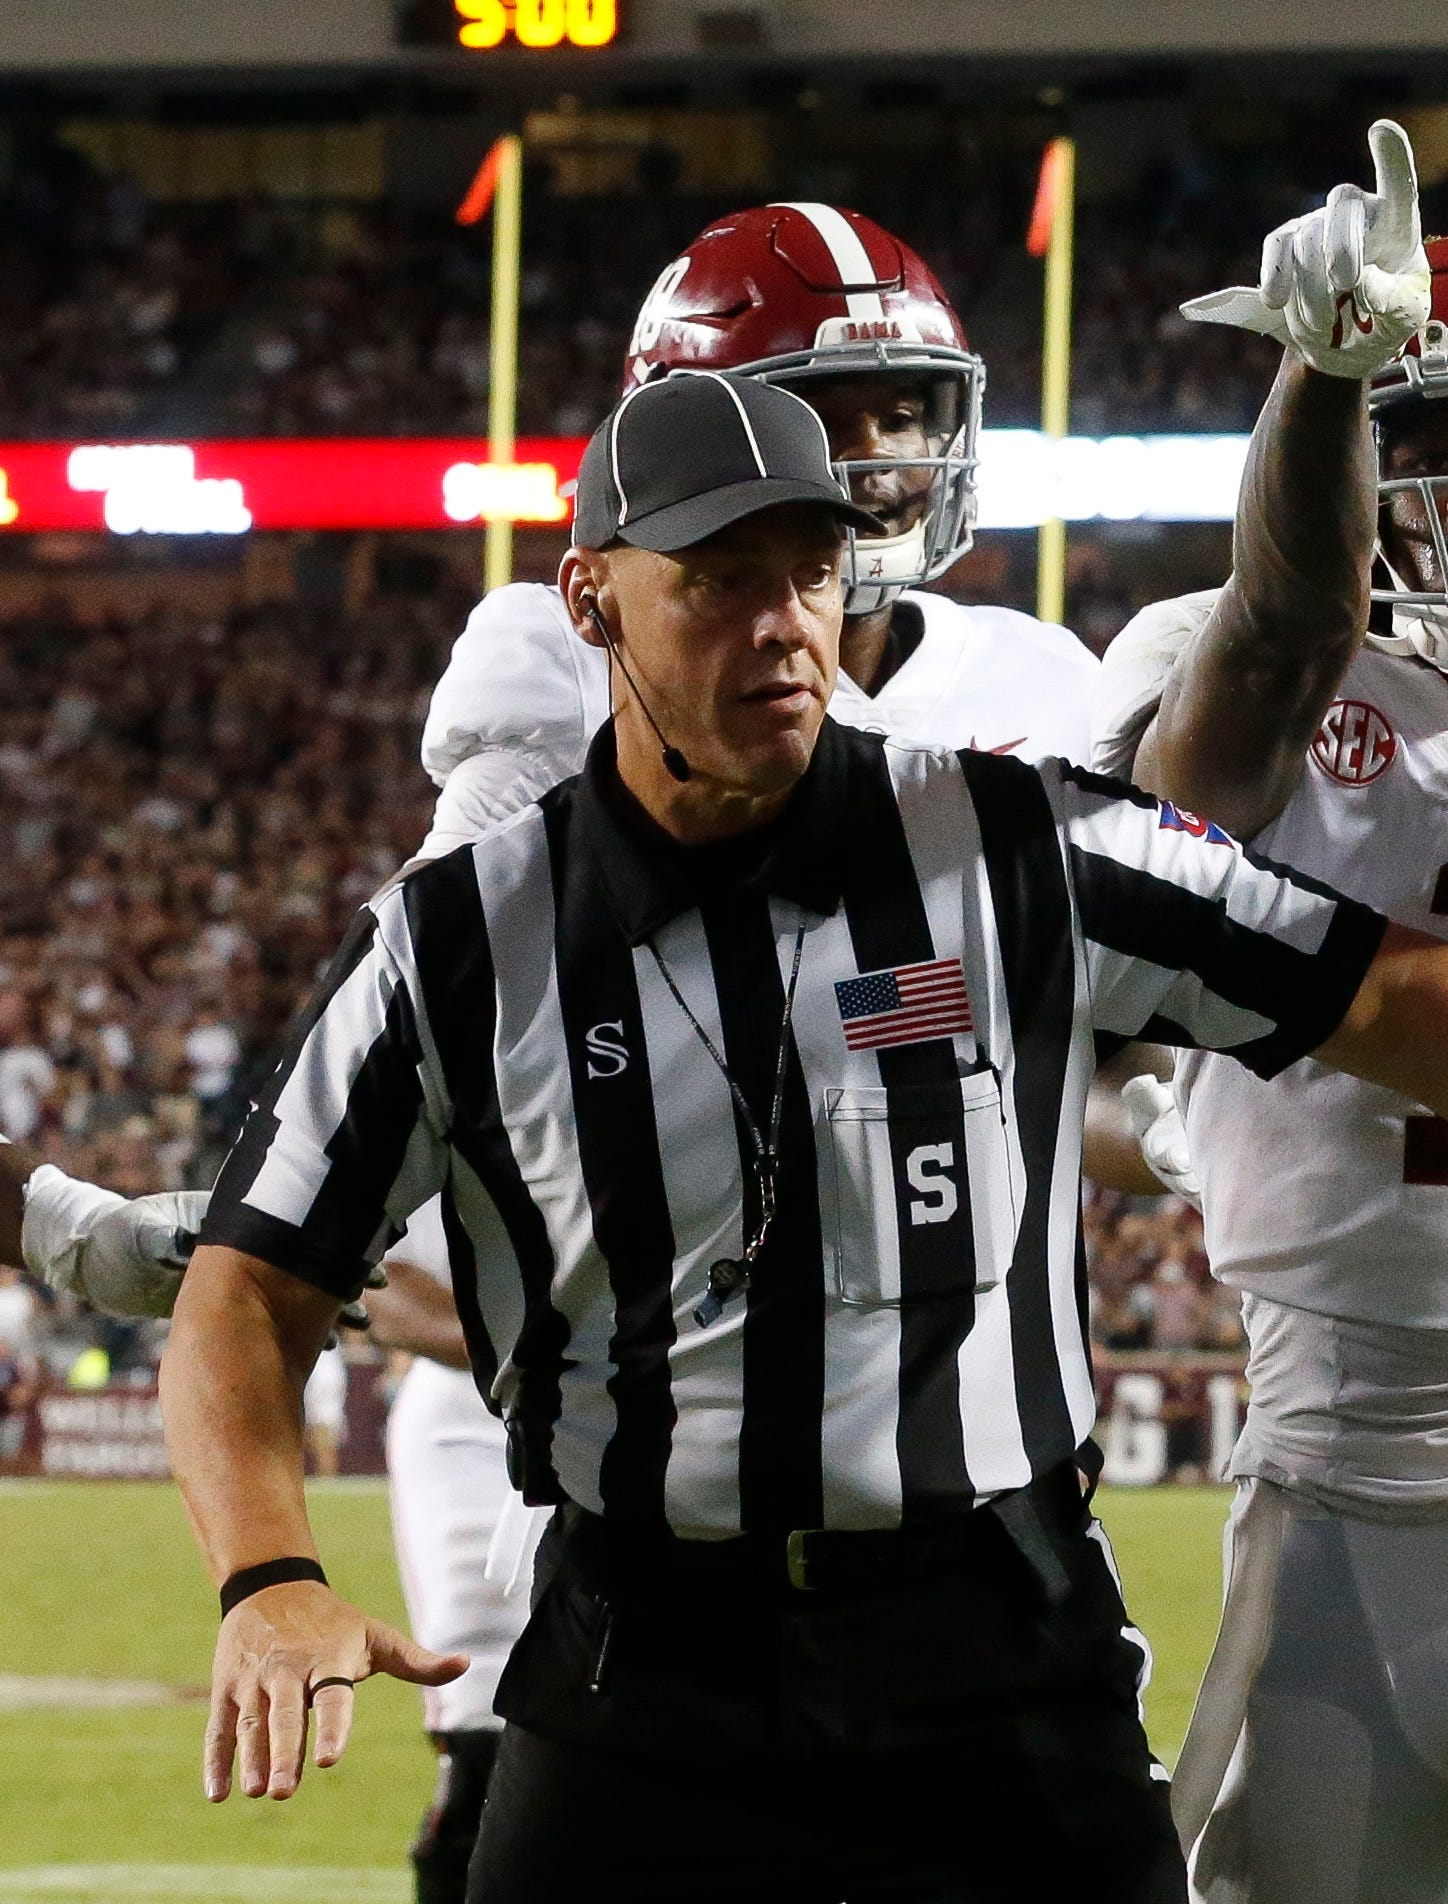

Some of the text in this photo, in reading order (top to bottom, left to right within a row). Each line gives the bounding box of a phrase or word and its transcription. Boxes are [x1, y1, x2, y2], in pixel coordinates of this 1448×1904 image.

[1315, 702, 1392, 781] SEC
[585, 1020, 630, 1079] S
[907, 1142, 957, 1225] S
